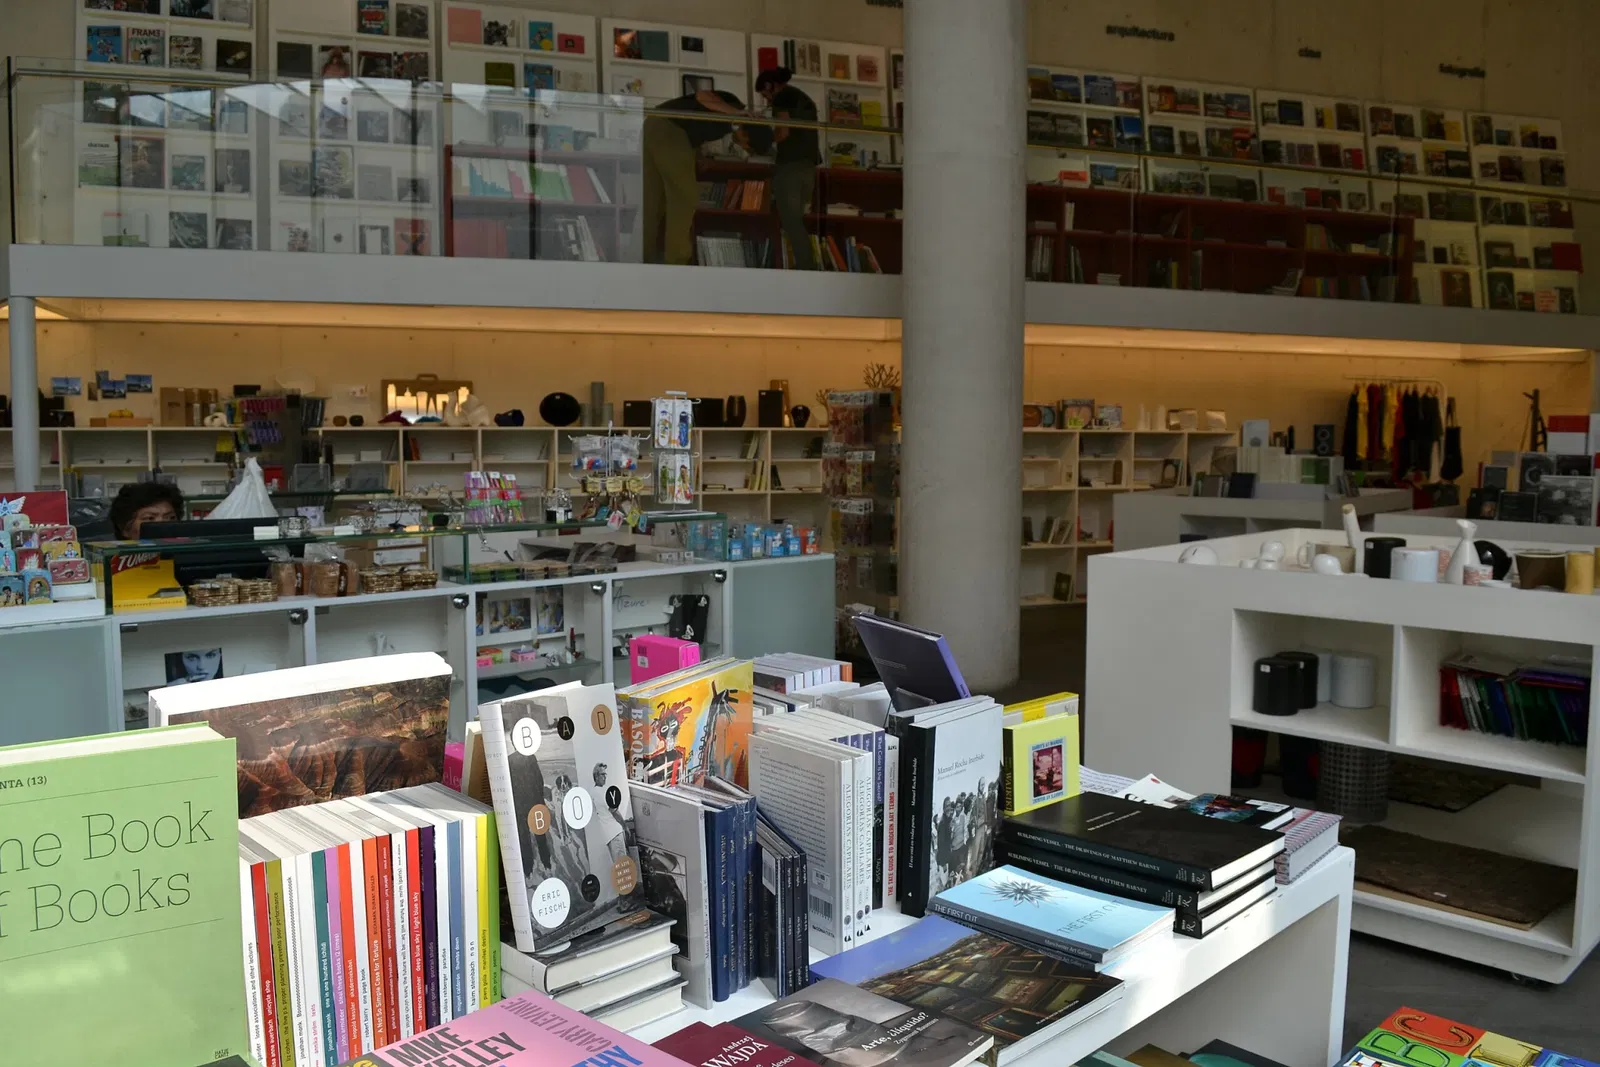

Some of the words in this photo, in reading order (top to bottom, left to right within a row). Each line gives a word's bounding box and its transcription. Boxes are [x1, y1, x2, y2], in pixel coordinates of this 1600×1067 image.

[27, 775, 48, 787] (13)
[858, 780, 866, 831] ALEGORÍAS
[81, 800, 215, 861] Book
[1017, 831, 1043, 844] SUBLIMING
[1042, 838, 1061, 847] VESSEL
[1074, 845, 1102, 857] DRAWINGS
[1110, 854, 1138, 867] MATTHEW
[1138, 861, 1161, 872] BARNEY
[1007, 852, 1033, 864] SUBLIMING
[1033, 859, 1050, 868] VESSEL
[1064, 866, 1091, 879] DRAWINGS
[1098, 875, 1126, 888] MATTHEW
[1126, 882, 1148, 894] BARNEY
[28, 868, 191, 933] Books
[541, 889, 561, 902] ERIC
[274, 892, 282, 926] performance
[538, 901, 567, 917] FISCHL
[935, 903, 947, 914] THE
[947, 906, 963, 919] FIRST
[964, 912, 978, 923] CUT
[1057, 920, 1084, 934] THE
[1081, 910, 1106, 925] FIRST
[276, 940, 284, 962] prevents
[1044, 938, 1069, 952] Manchester
[1069, 945, 1077, 954] Art
[1077, 947, 1093, 959] Gallery
[278, 964, 286, 986] planning
[347, 960, 355, 997] akademiekabel
[251, 991, 259, 1023] associations
[265, 994, 273, 1015] unicycle
[280, 987, 288, 1004] proper
[374, 987, 382, 1007] Simple
[499, 994, 566, 1031] LEVINE
[326, 1030, 334, 1051] jonathan
[553, 1019, 613, 1053] CARY
[722, 1035, 754, 1053] Andrzej
[860, 1035, 892, 1053] Arte,
[887, 1011, 929, 1039] ¿líquido?
[298, 1038, 306, 1059] jonathan
[385, 1027, 474, 1067] MIKE
[701, 1041, 769, 1067] WAJDA
